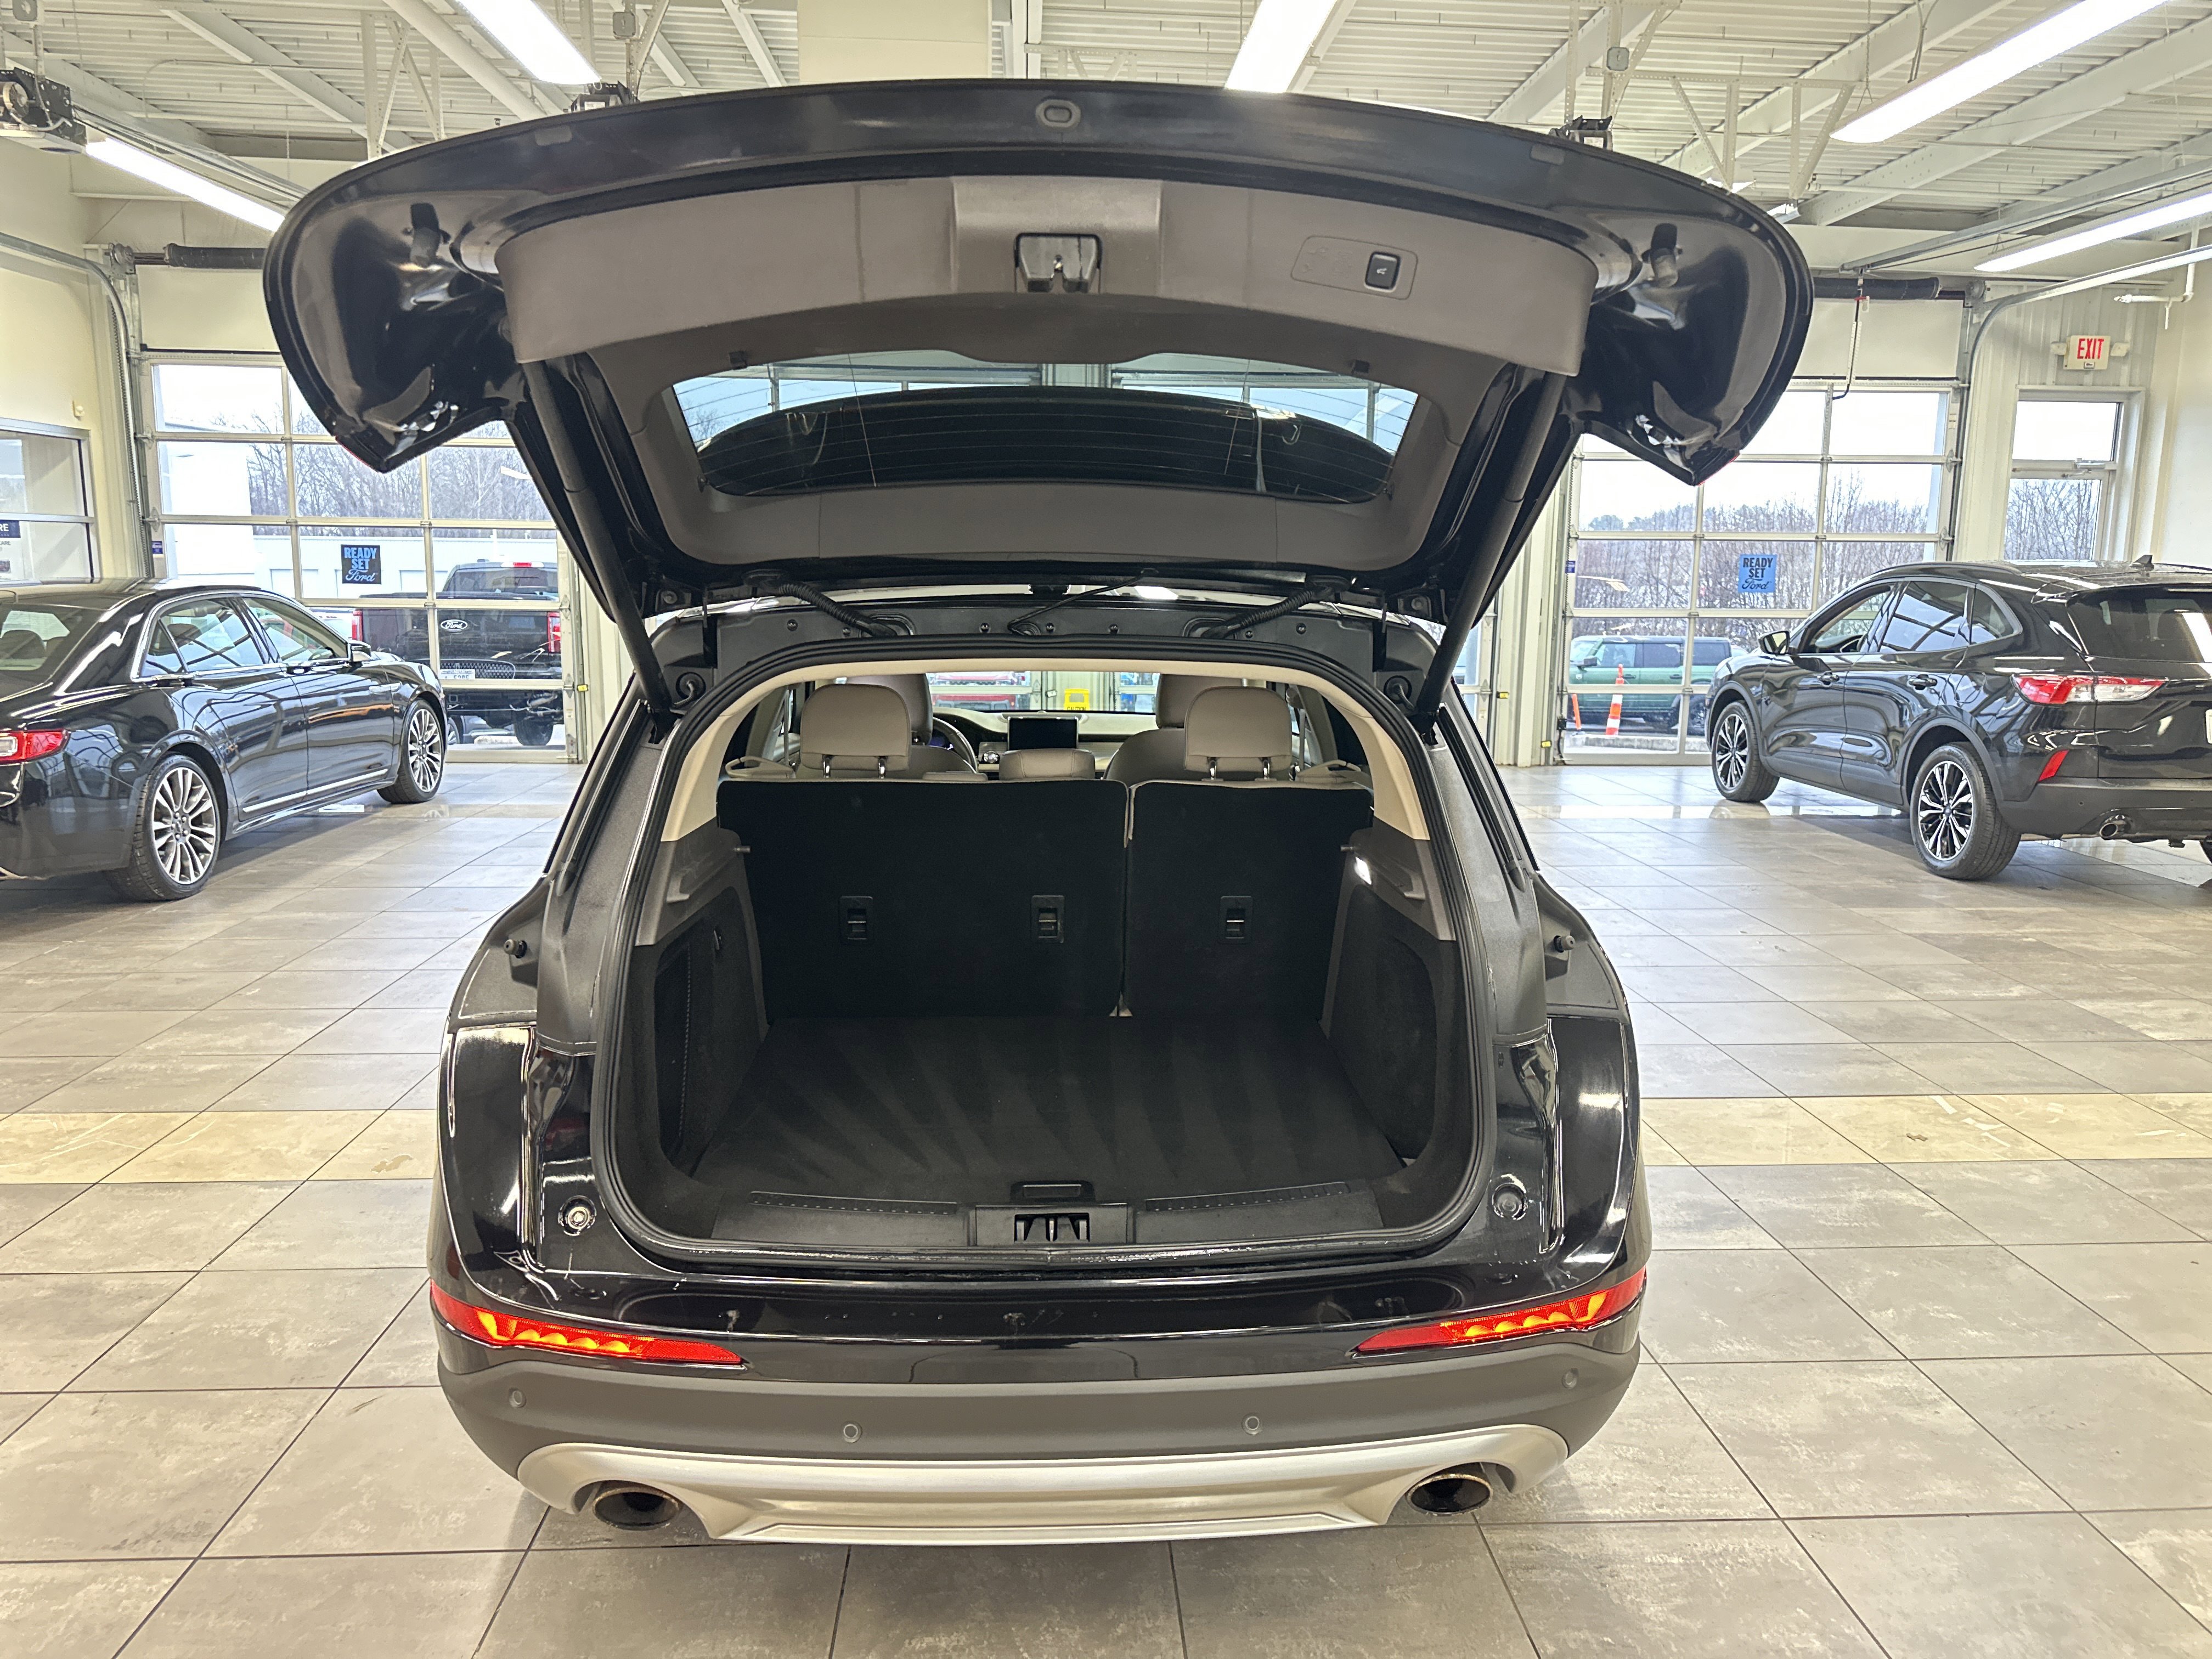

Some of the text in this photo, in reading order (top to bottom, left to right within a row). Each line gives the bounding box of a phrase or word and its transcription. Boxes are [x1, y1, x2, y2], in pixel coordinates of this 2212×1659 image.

[2077, 338, 2104, 359] EXIT
[344, 547, 377, 559] READY
[351, 558, 370, 569] SET
[1743, 557, 1773, 568] READY
[345, 568, 376, 582] Ford
[1748, 568, 1765, 578] SET
[1742, 578, 1770, 589] Ford
